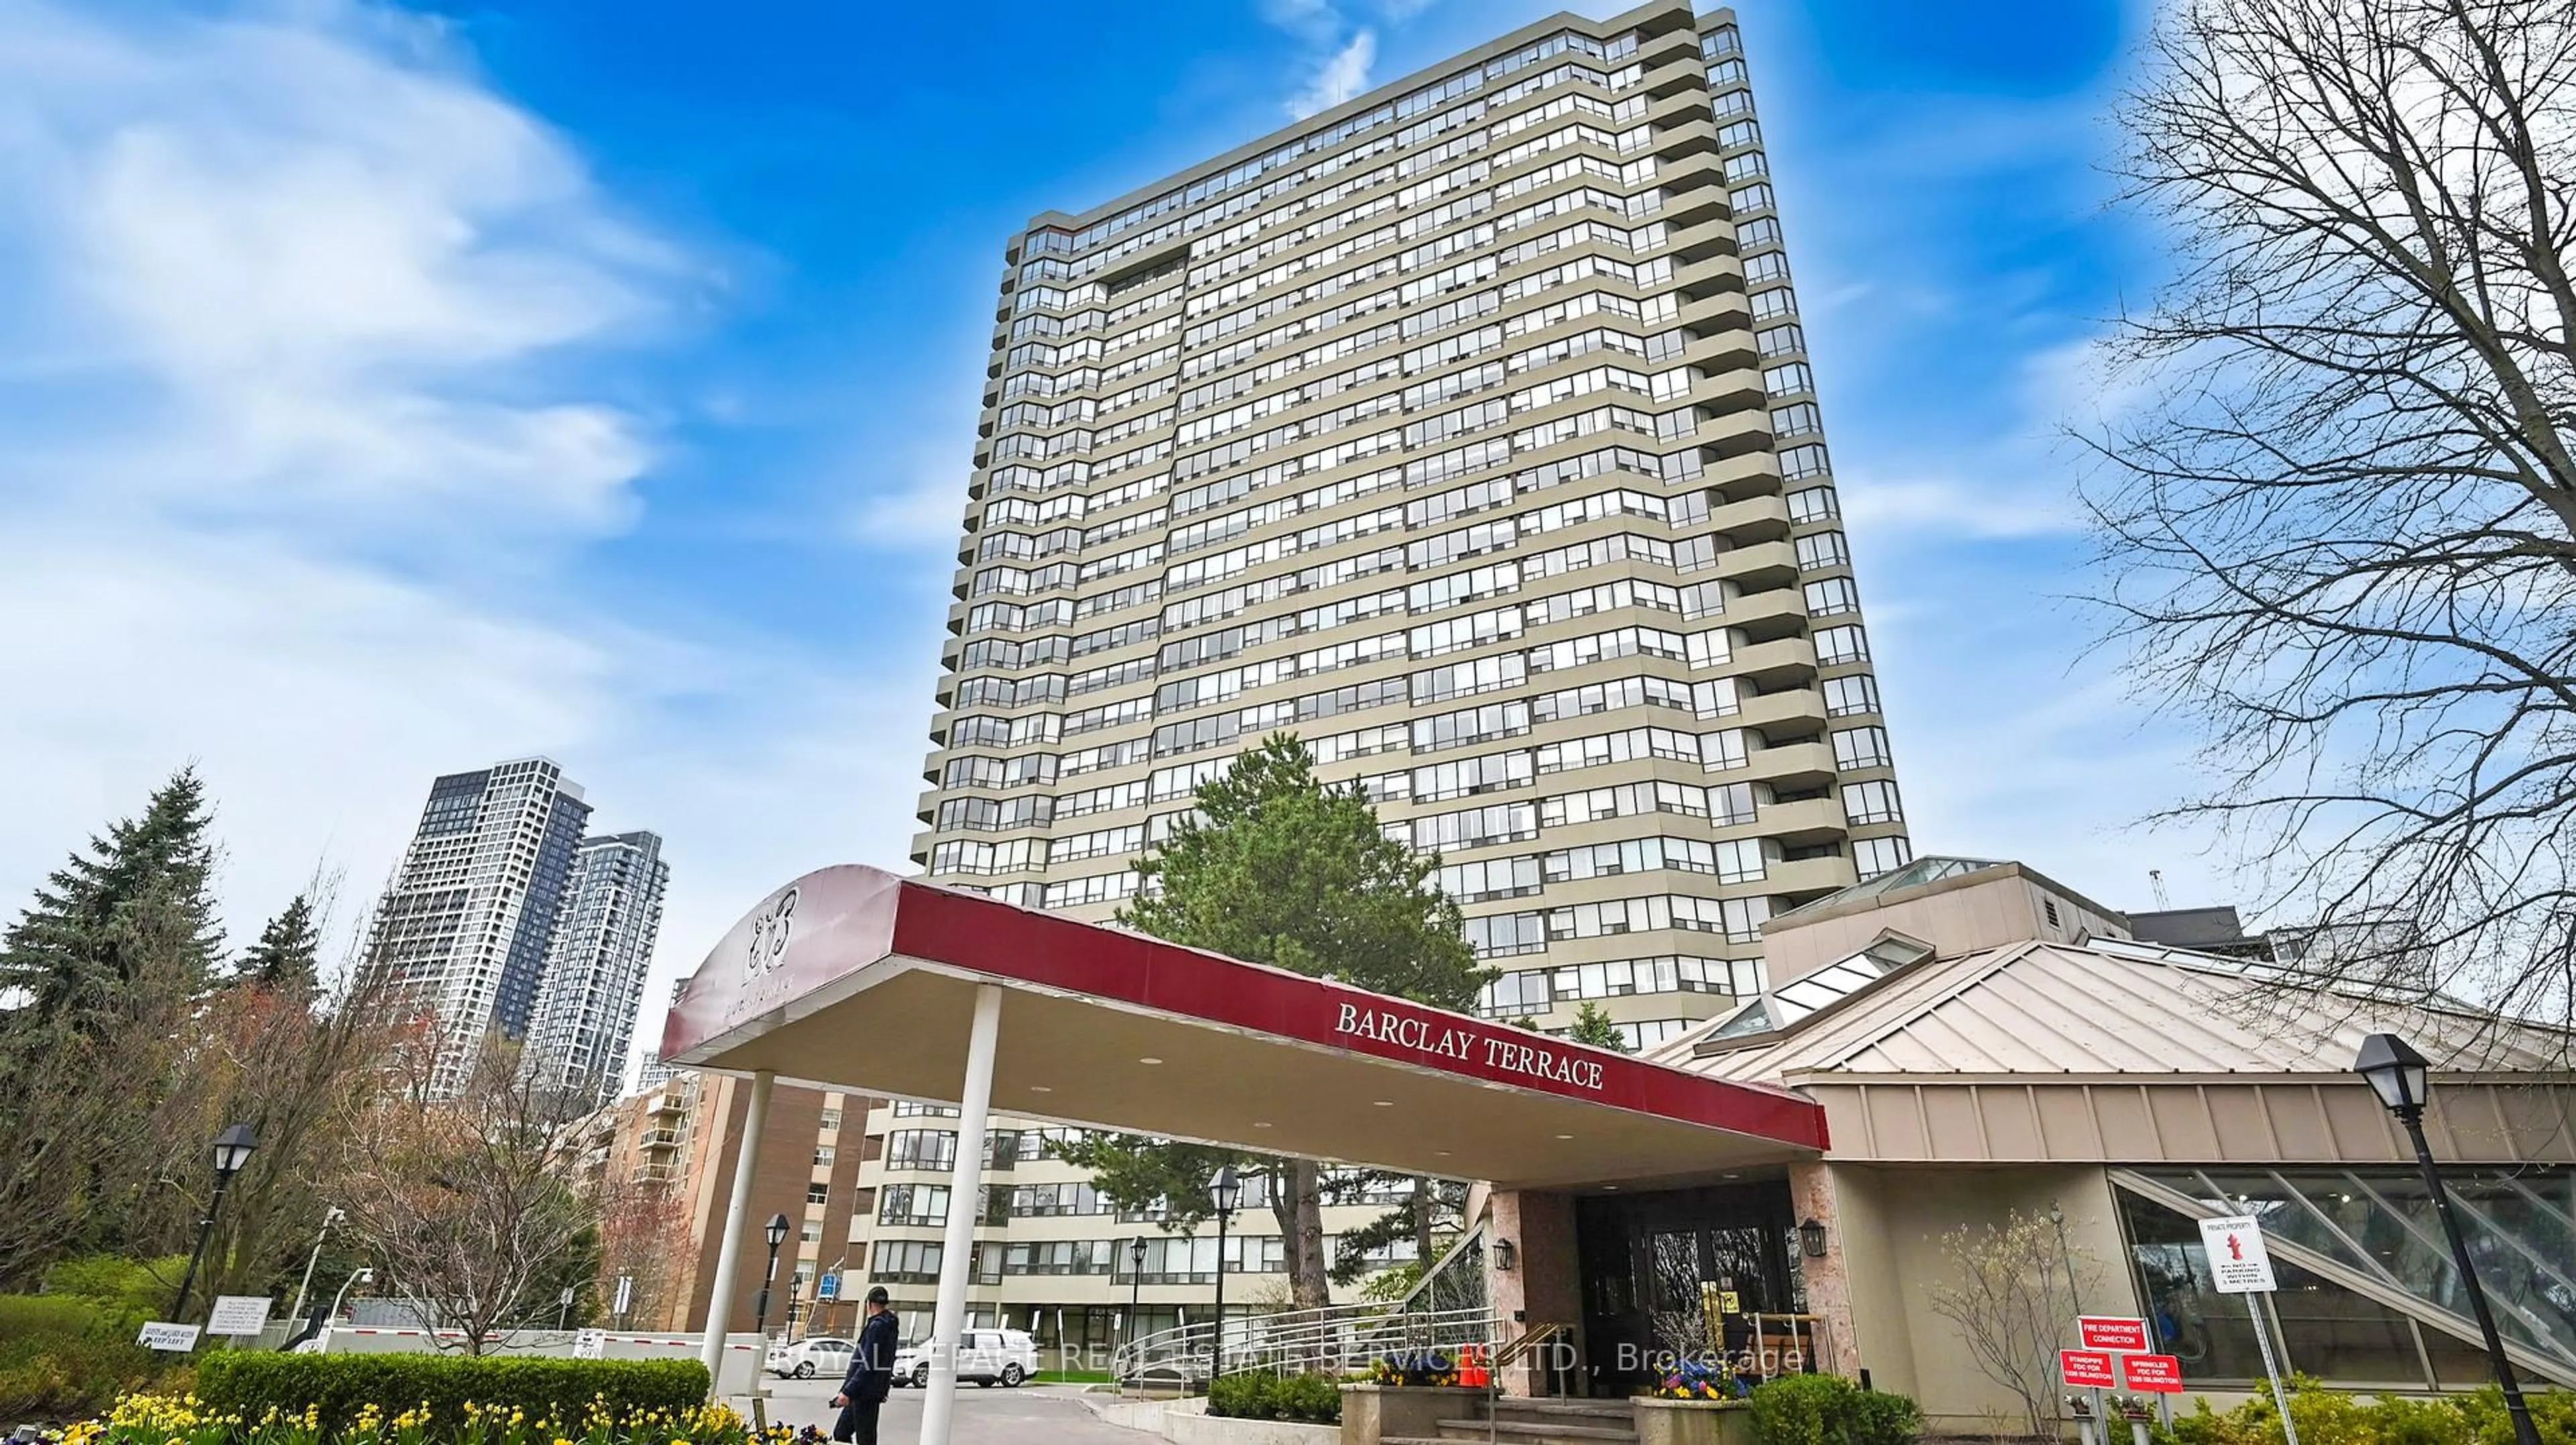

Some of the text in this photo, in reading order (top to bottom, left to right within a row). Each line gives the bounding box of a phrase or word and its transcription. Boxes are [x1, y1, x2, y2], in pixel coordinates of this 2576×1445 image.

[1335, 1003, 1603, 1090] BARCLAY TERRACE
[2084, 1324, 2141, 1334] FIRE DEPARTMENT
[2093, 1335, 2136, 1344] CONNECTION
[2087, 1364, 2101, 1372] FOR
[2131, 1360, 2169, 1369] SPRINKLER
[2079, 1371, 2113, 1380] ISLINGTON
[2143, 1376, 2180, 1385] ISLINGTON
